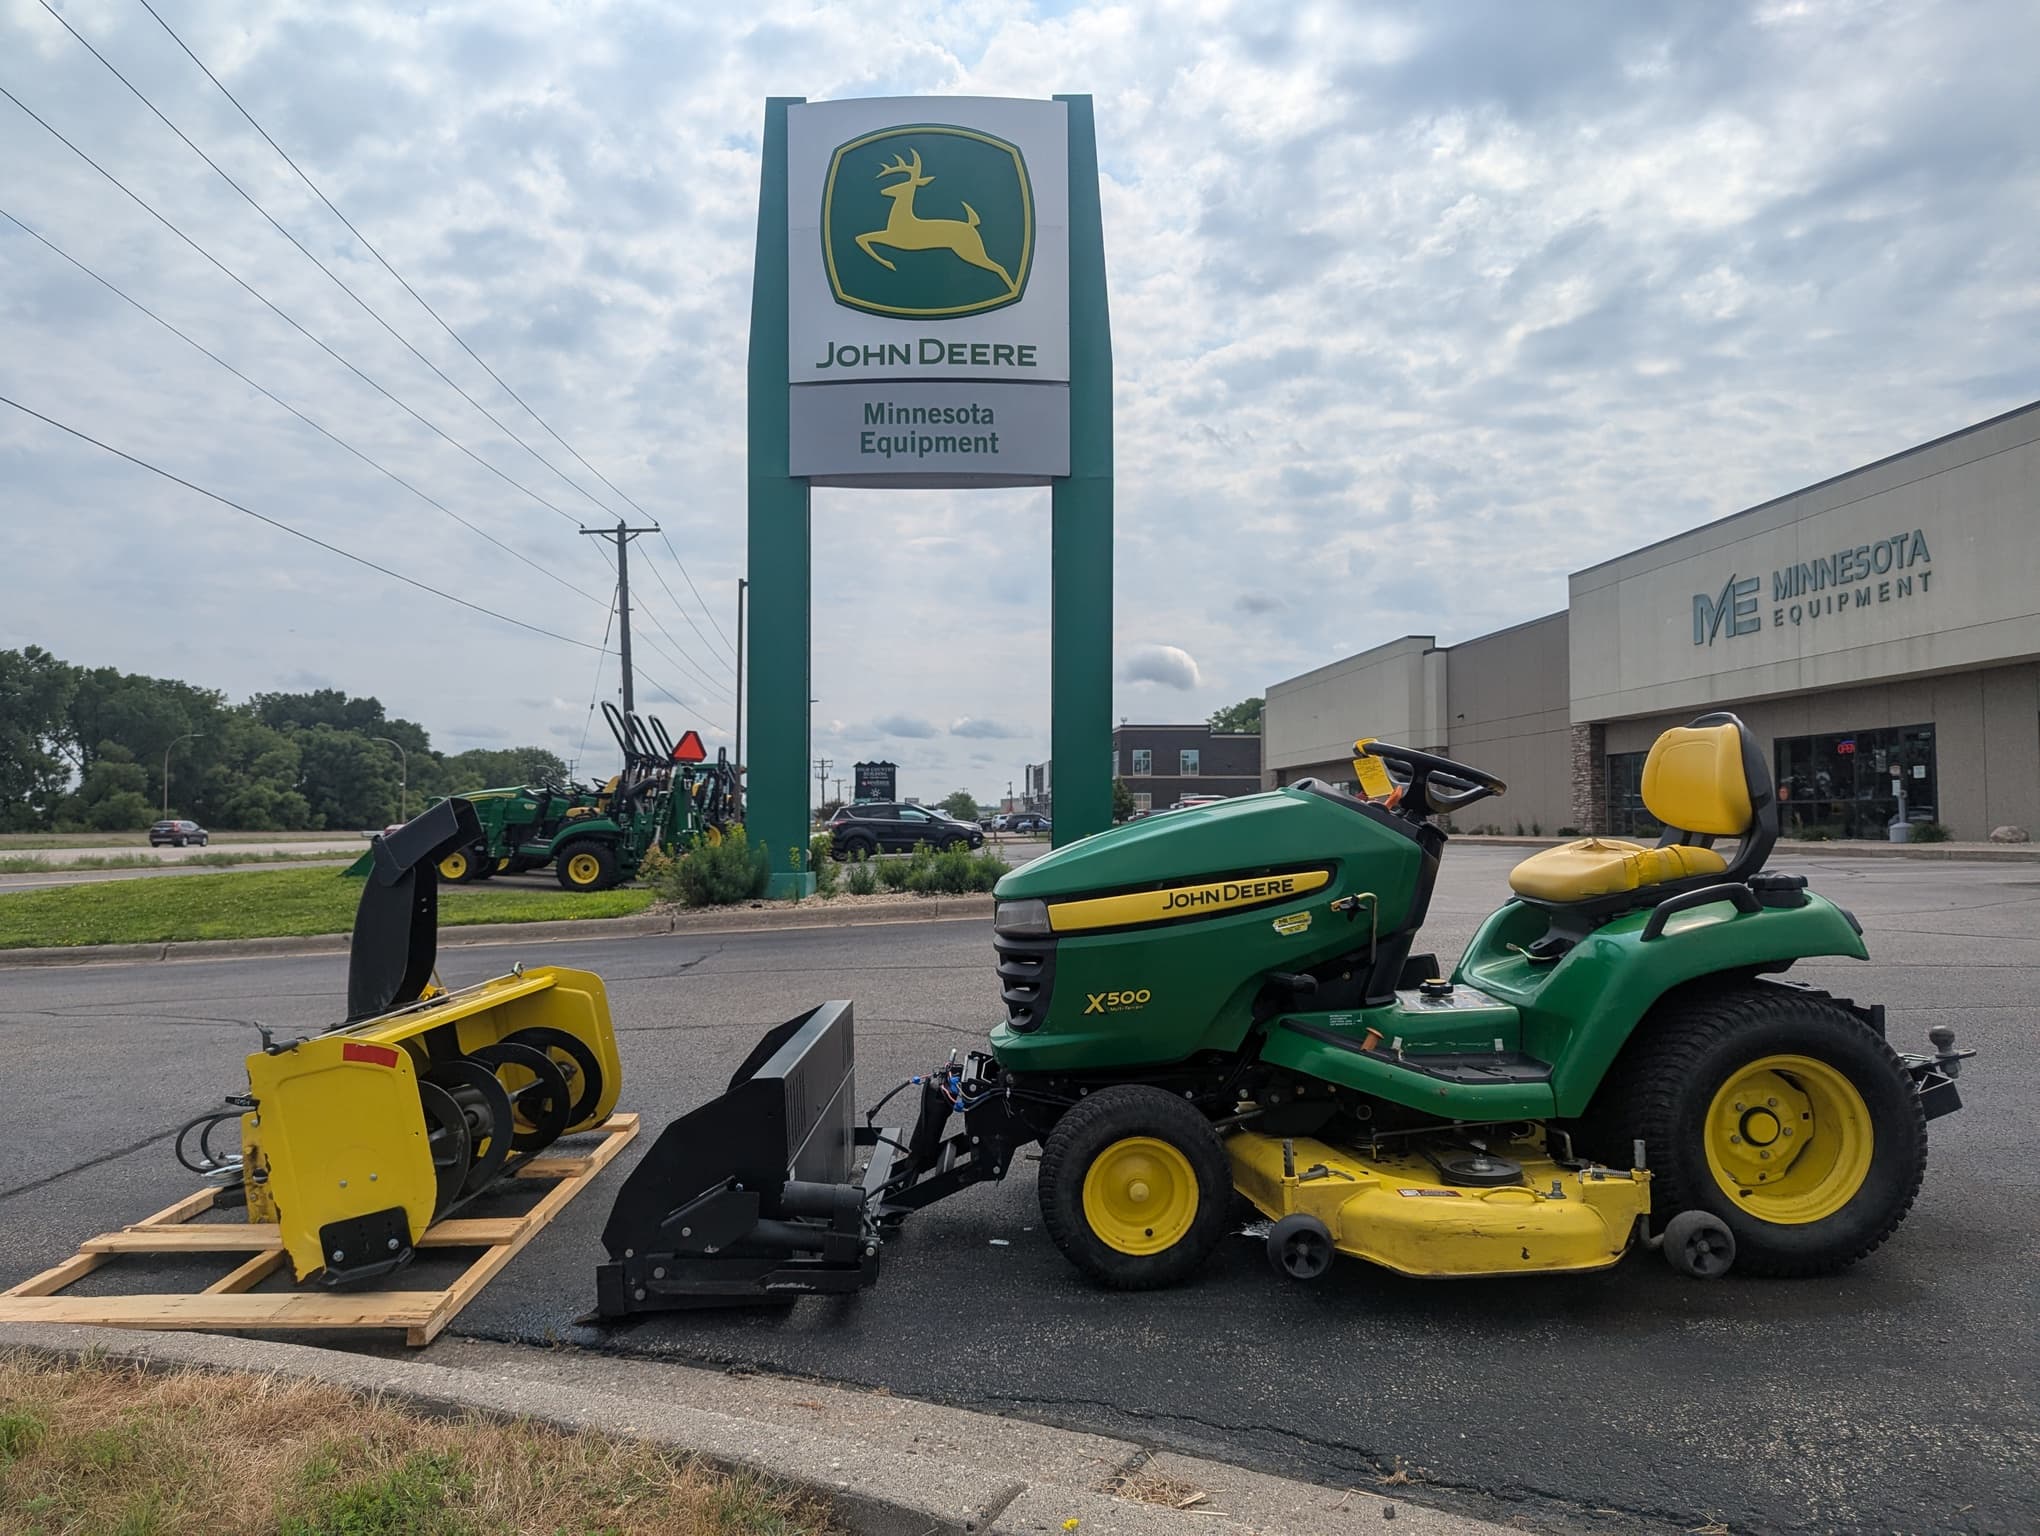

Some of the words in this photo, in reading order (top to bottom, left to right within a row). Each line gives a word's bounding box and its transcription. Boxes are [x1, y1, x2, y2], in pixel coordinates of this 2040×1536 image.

[816, 341, 911, 368] JOHN
[919, 338, 1037, 367] DEERE
[864, 402, 994, 425] Minnesota
[860, 430, 999, 458] Equipment
[1772, 528, 1931, 602] MINNESOTA
[1774, 571, 1932, 627] EQUIPMENT
[1162, 889, 1220, 910] JOHN
[1223, 878, 1294, 902] DEERE
[1084, 989, 1151, 1015] X500
